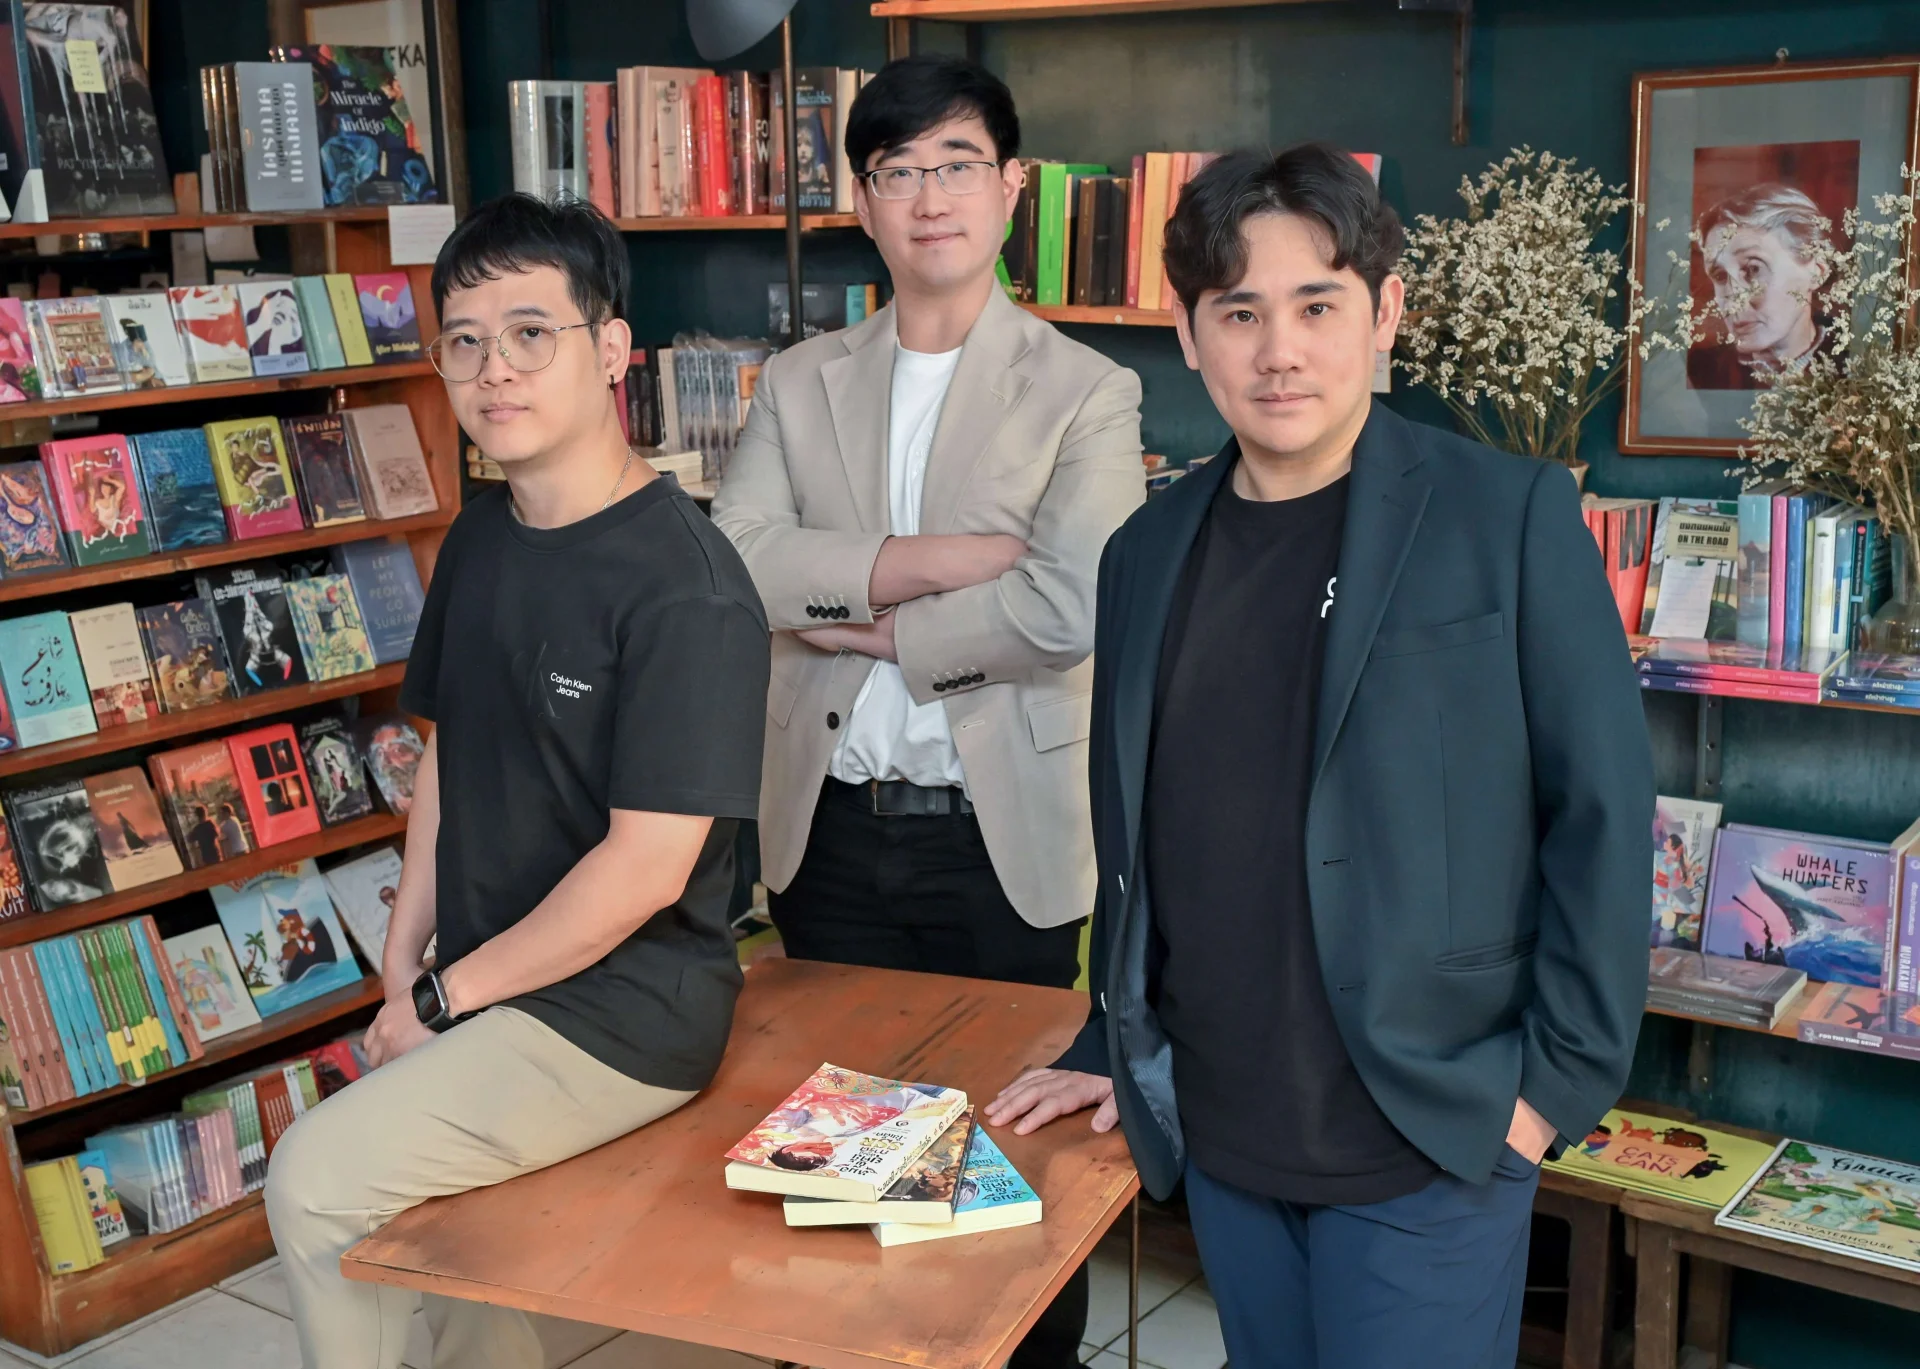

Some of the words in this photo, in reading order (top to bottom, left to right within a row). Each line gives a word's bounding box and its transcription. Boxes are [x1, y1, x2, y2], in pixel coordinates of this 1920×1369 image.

[331, 91, 382, 106] Miracle
[340, 117, 386, 135] Indigo
[1677, 534, 1689, 544] ON
[1690, 535, 1704, 545] THE
[1706, 536, 1729, 546] ROAD
[550, 672, 573, 687] Calvin
[573, 679, 592, 692] Klein
[556, 685, 580, 698] Jeans
[1797, 854, 1858, 876] WHALE
[1782, 868, 1868, 895] HUNTERS
[1897, 944, 1912, 992] MURAKAMI
[1832, 1034, 1844, 1042] THE
[1844, 1036, 1860, 1044] TIME
[859, 1137, 904, 1151] SSR
[1614, 1155, 1672, 1173] CAN
[1623, 1146, 1678, 1166] CATS
[1769, 1217, 1801, 1228] KATE
[1805, 1226, 1894, 1250] WATERHOUSE
